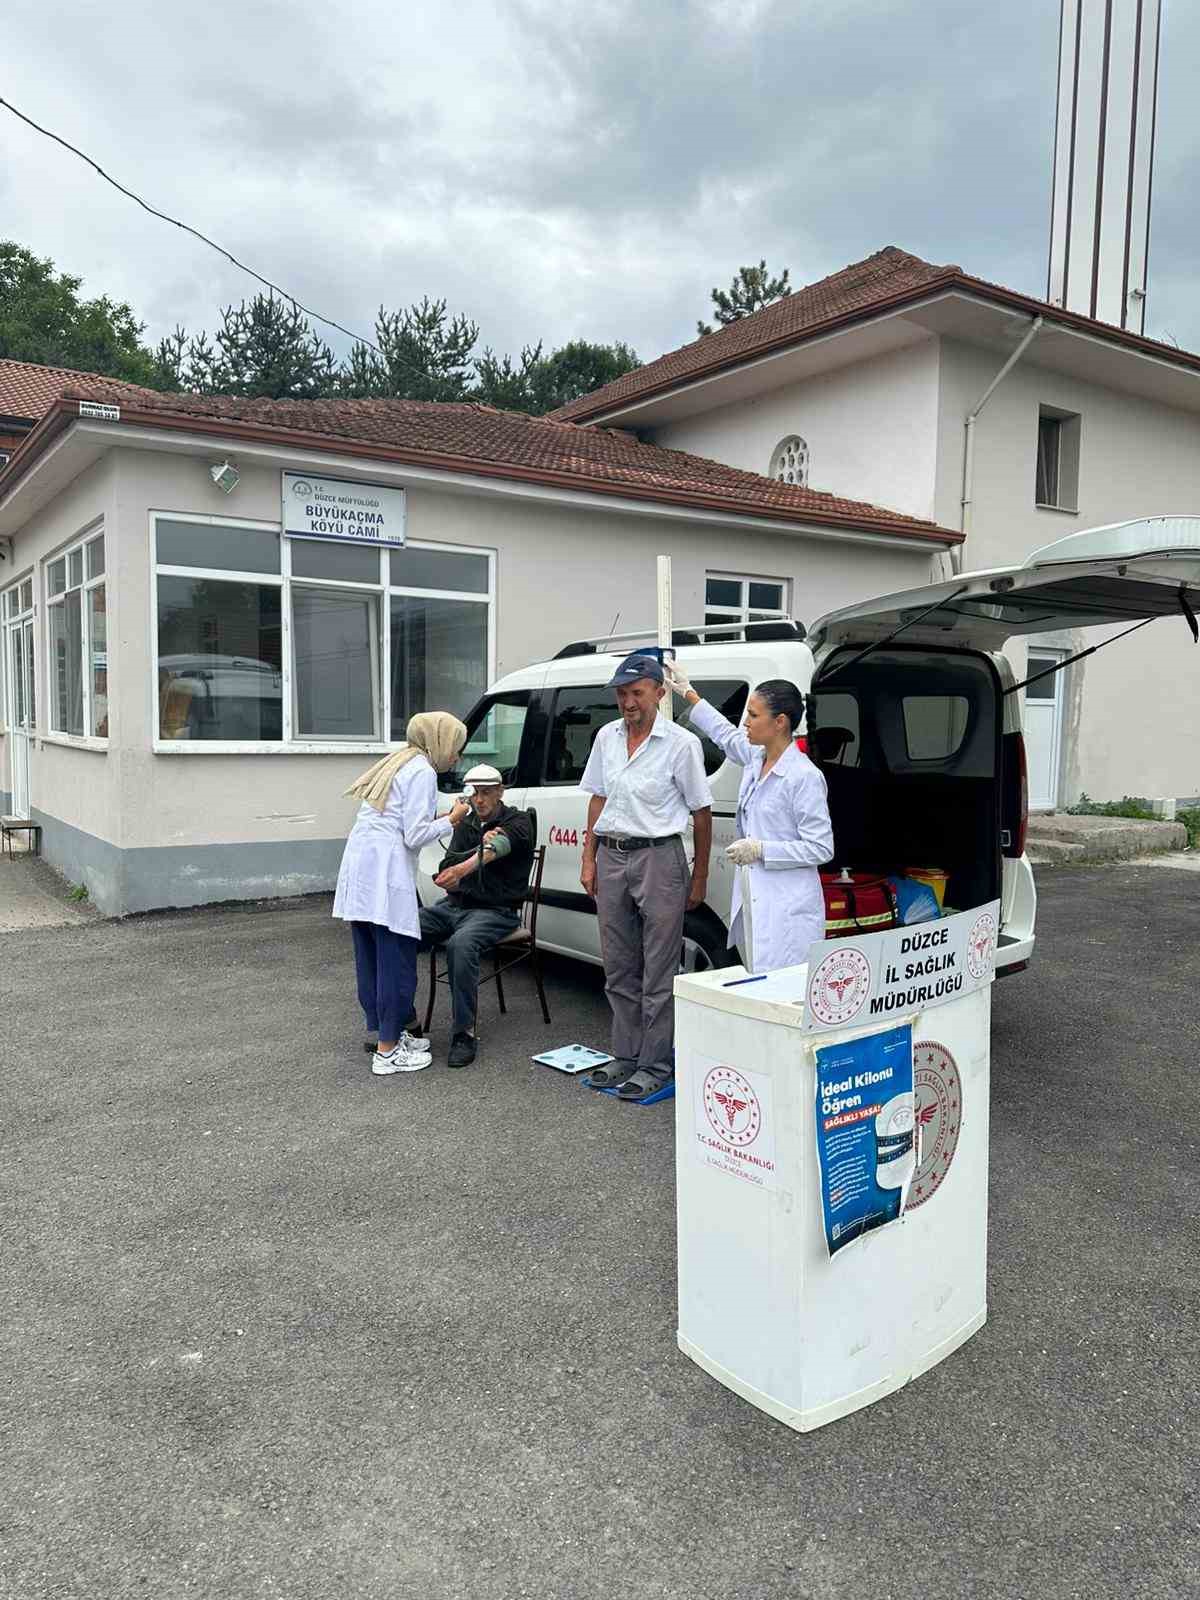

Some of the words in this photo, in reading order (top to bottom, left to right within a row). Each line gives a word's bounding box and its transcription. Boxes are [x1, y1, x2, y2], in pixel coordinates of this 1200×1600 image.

[314, 493, 336, 502] DÜZCE
[306, 504, 384, 525] BÜYÜKAÇMA
[311, 519, 343, 534] KÖYÜ
[348, 525, 379, 538] CAMİ
[555, 829, 578, 846] 444
[901, 928, 949, 953] DÜZCE
[885, 965, 899, 984] İL
[904, 952, 956, 980] SAĞLIK
[870, 973, 963, 1014] MÜDÜRLÜĞÜ
[820, 1076, 852, 1098] İdeal
[854, 1067, 893, 1088] Kilonu
[822, 1094, 862, 1114] Öğren
[825, 1112, 858, 1129] SAĞLIKLI
[708, 1138, 732, 1153] SAĞLIK
[733, 1148, 775, 1171] BAKANLIĞI
